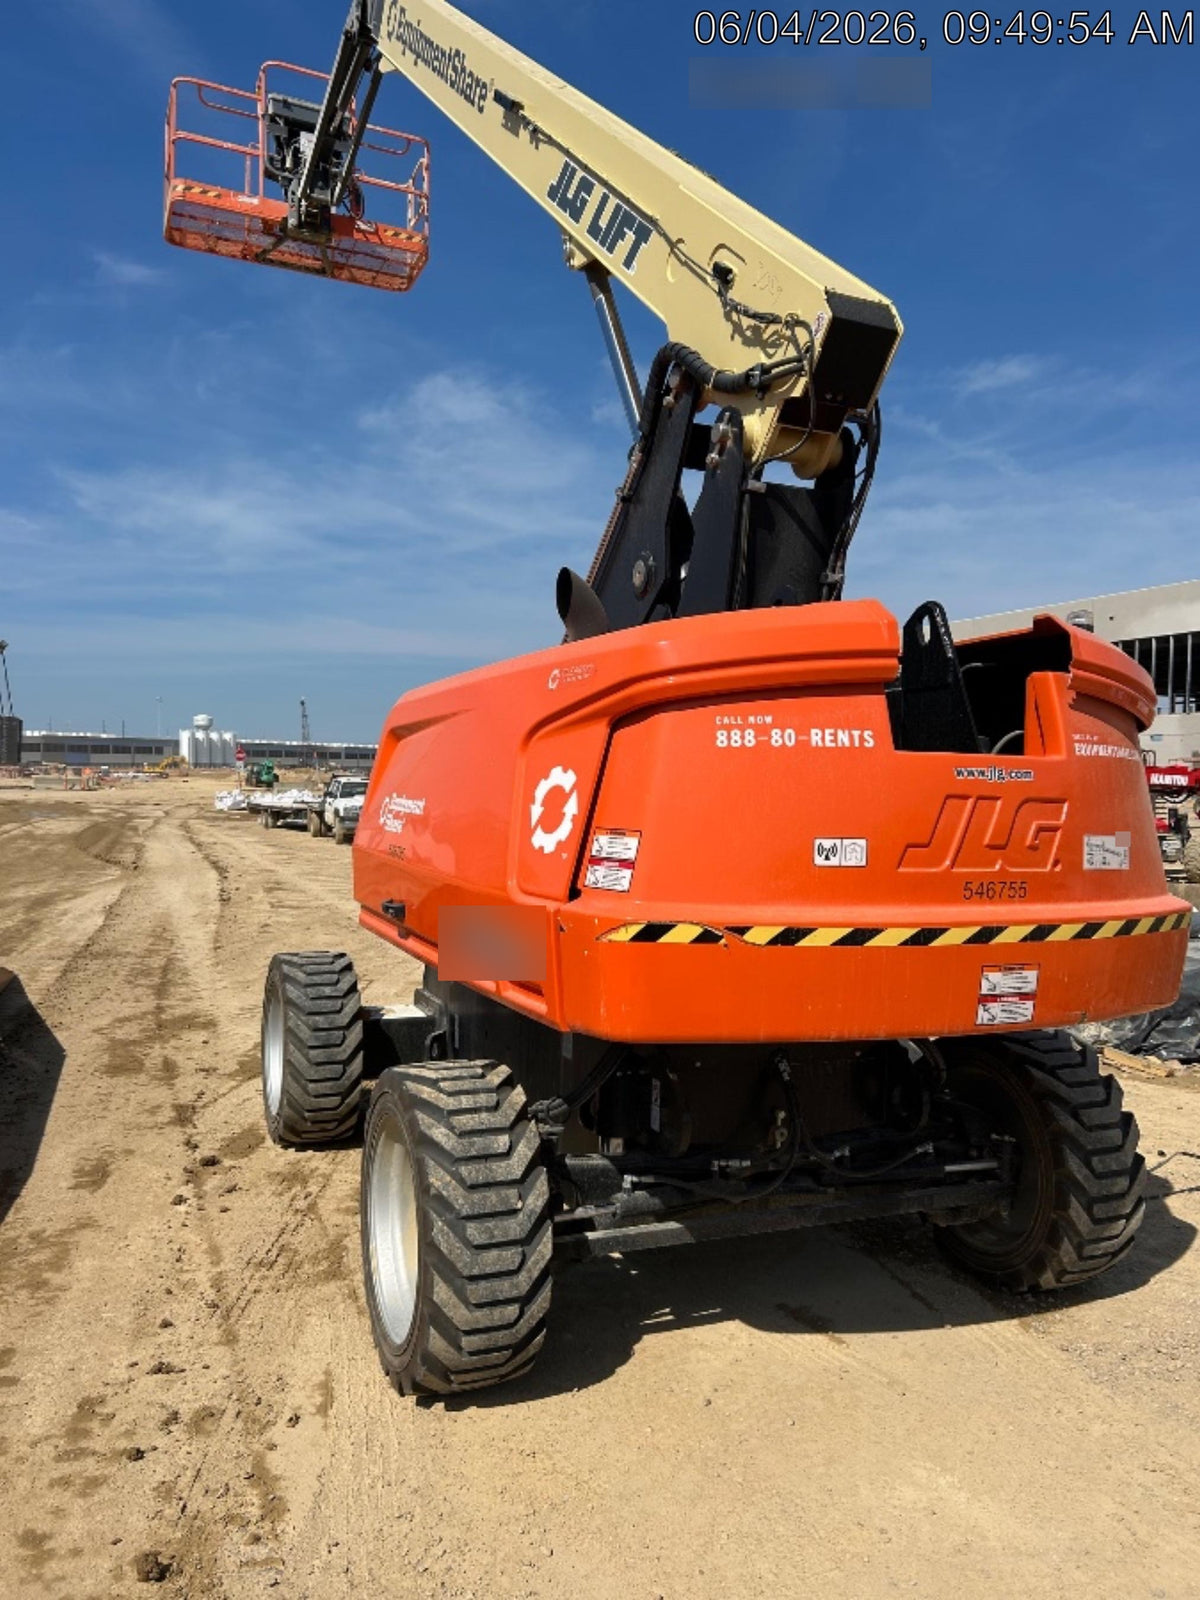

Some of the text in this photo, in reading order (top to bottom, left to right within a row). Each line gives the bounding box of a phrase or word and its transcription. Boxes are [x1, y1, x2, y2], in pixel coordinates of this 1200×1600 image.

[396, 5, 488, 114] EquipmentShare
[547, 158, 655, 275] JLG LIFT
[715, 715, 773, 725] CALL NOW
[715, 728, 875, 748] 888-80-RENTS
[954, 765, 1034, 783] www.jlg.com
[897, 794, 1069, 872] JLG
[962, 881, 1028, 901] 546755
